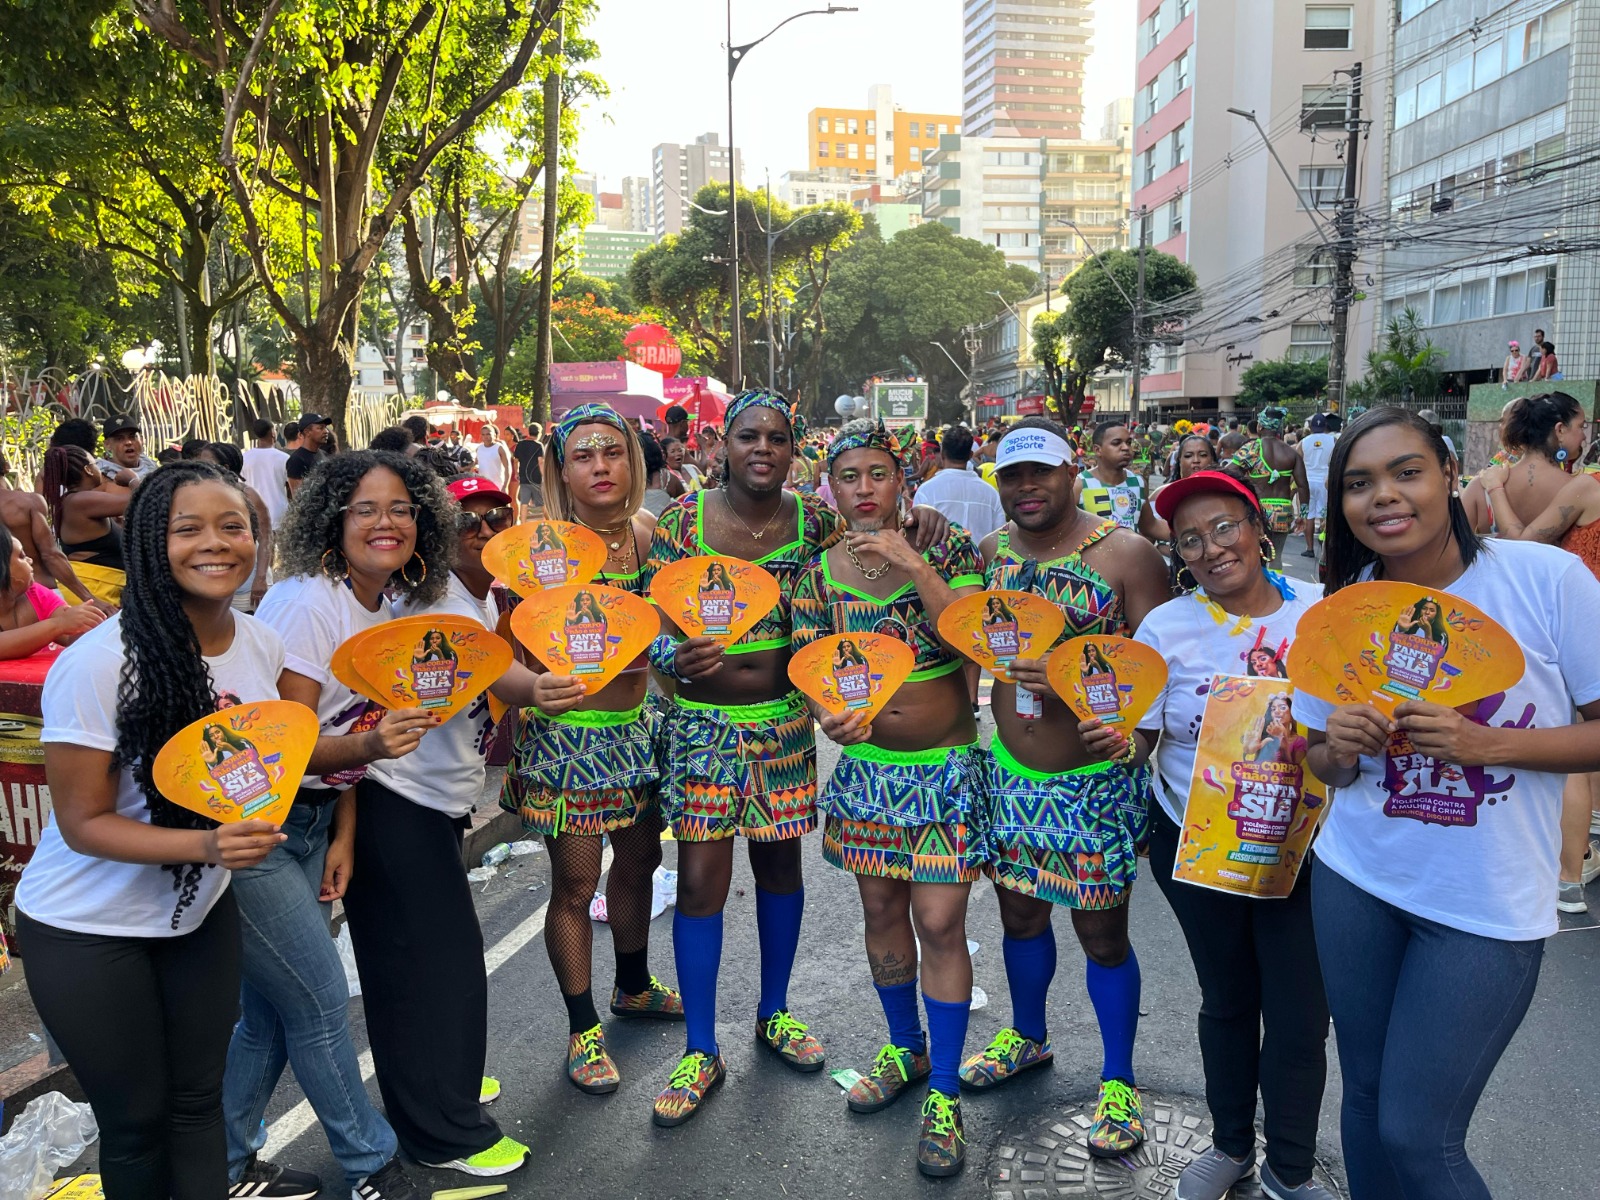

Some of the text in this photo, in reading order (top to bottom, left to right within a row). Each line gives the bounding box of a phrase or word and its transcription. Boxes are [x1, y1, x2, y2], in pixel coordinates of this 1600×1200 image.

[1016, 442, 1044, 450] Sorte
[1409, 636, 1438, 648] CORPO
[1393, 644, 1434, 663] FANTA
[417, 670, 450, 678] FANTA
[839, 674, 865, 682] FANTA
[1086, 684, 1113, 692] FANTA
[1390, 740, 1415, 756] nã
[219, 761, 257, 784] FANTA
[1261, 761, 1298, 773] CORPO
[1243, 771, 1268, 782] não
[1271, 772, 1280, 784] é
[1240, 780, 1297, 798] FANTA
[1433, 799, 1466, 808] CONTRA
